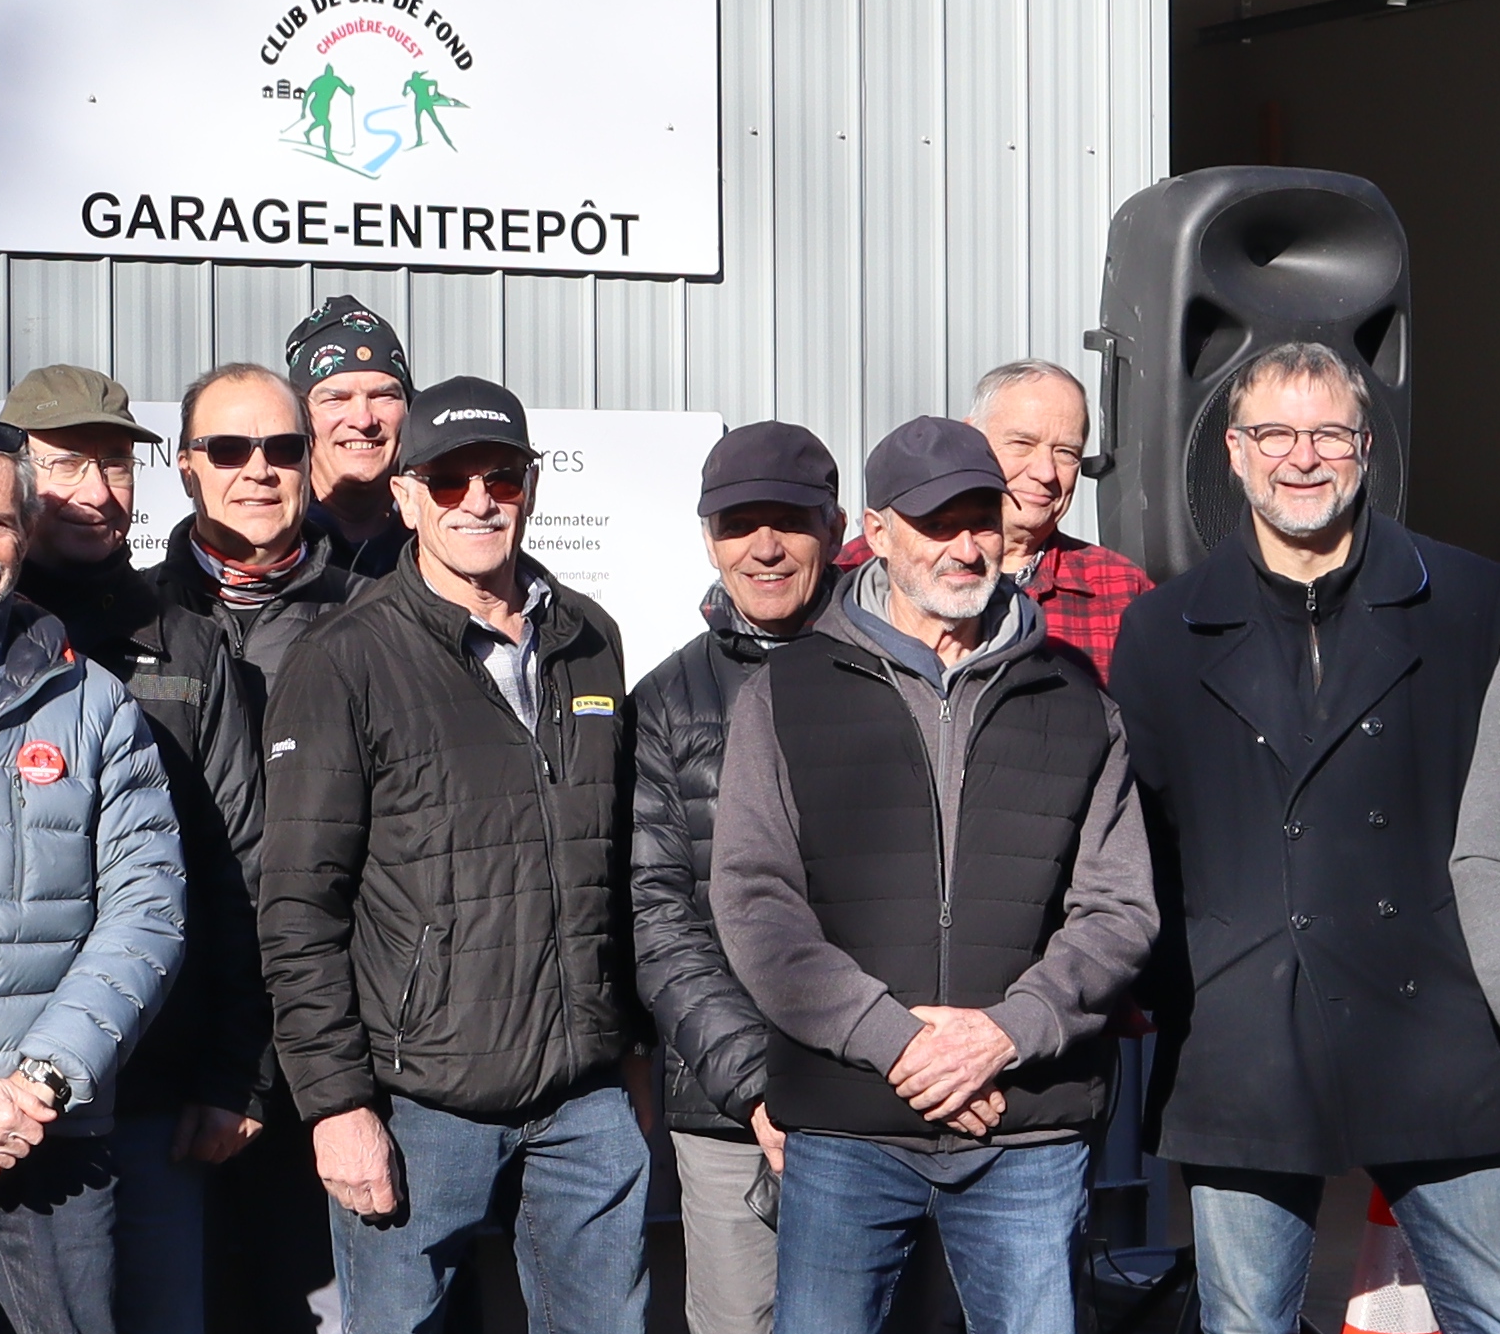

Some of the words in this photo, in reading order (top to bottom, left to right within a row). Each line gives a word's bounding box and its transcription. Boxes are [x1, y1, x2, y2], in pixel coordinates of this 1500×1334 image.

[260, 5, 308, 65] CLUB
[424, 10, 473, 71] FOND
[316, 16, 424, 59] CHAUDIÈRE-OUEST
[81, 192, 640, 256] GARAGE-ENTREPÔT
[449, 408, 512, 424] HONDA
[528, 511, 610, 527] rdonnateur
[528, 534, 602, 551] bénévoles
[554, 570, 610, 583] amontagne
